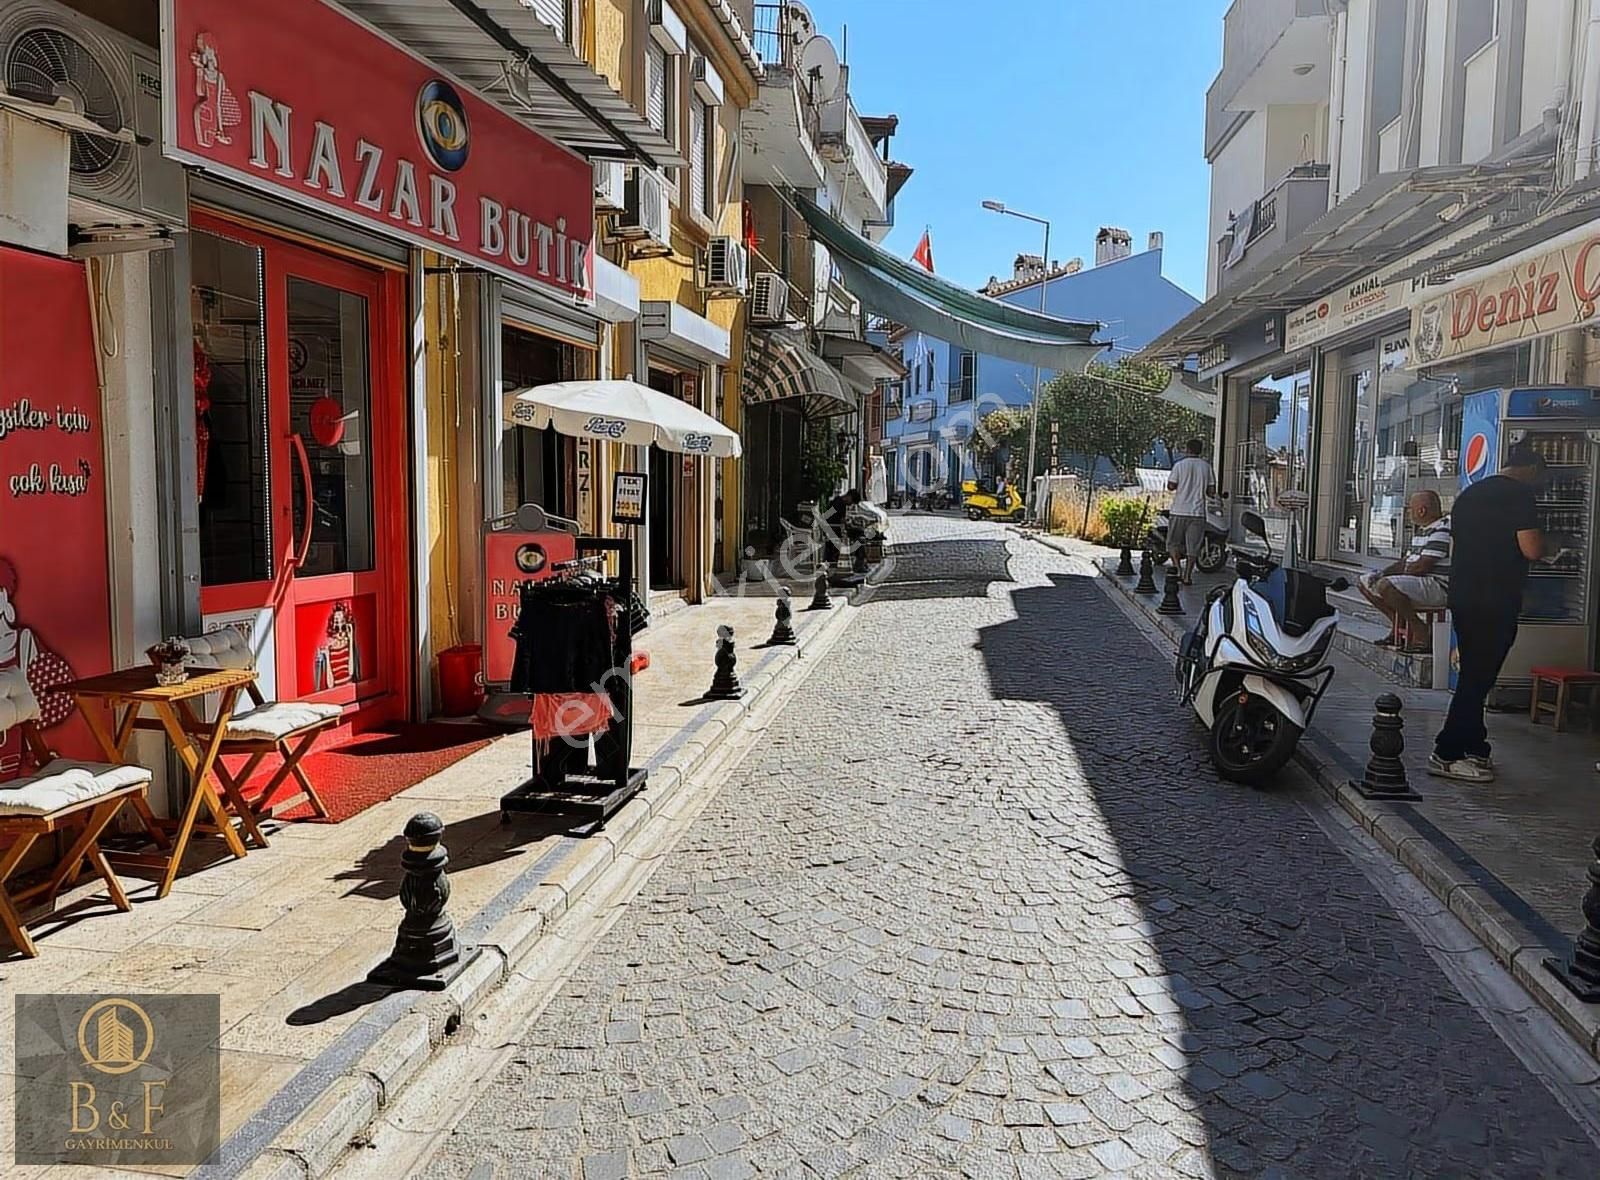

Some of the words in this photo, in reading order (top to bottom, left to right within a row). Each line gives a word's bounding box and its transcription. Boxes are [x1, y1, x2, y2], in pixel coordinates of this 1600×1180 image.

[248, 91, 459, 242] NAZAR
[479, 195, 593, 293] BUTİK
[1349, 276, 1380, 300] KANAL
[1450, 262, 1560, 340] Deniz
[56, 404, 91, 432] için
[9, 462, 46, 497] çok
[49, 463, 88, 496] kısa
